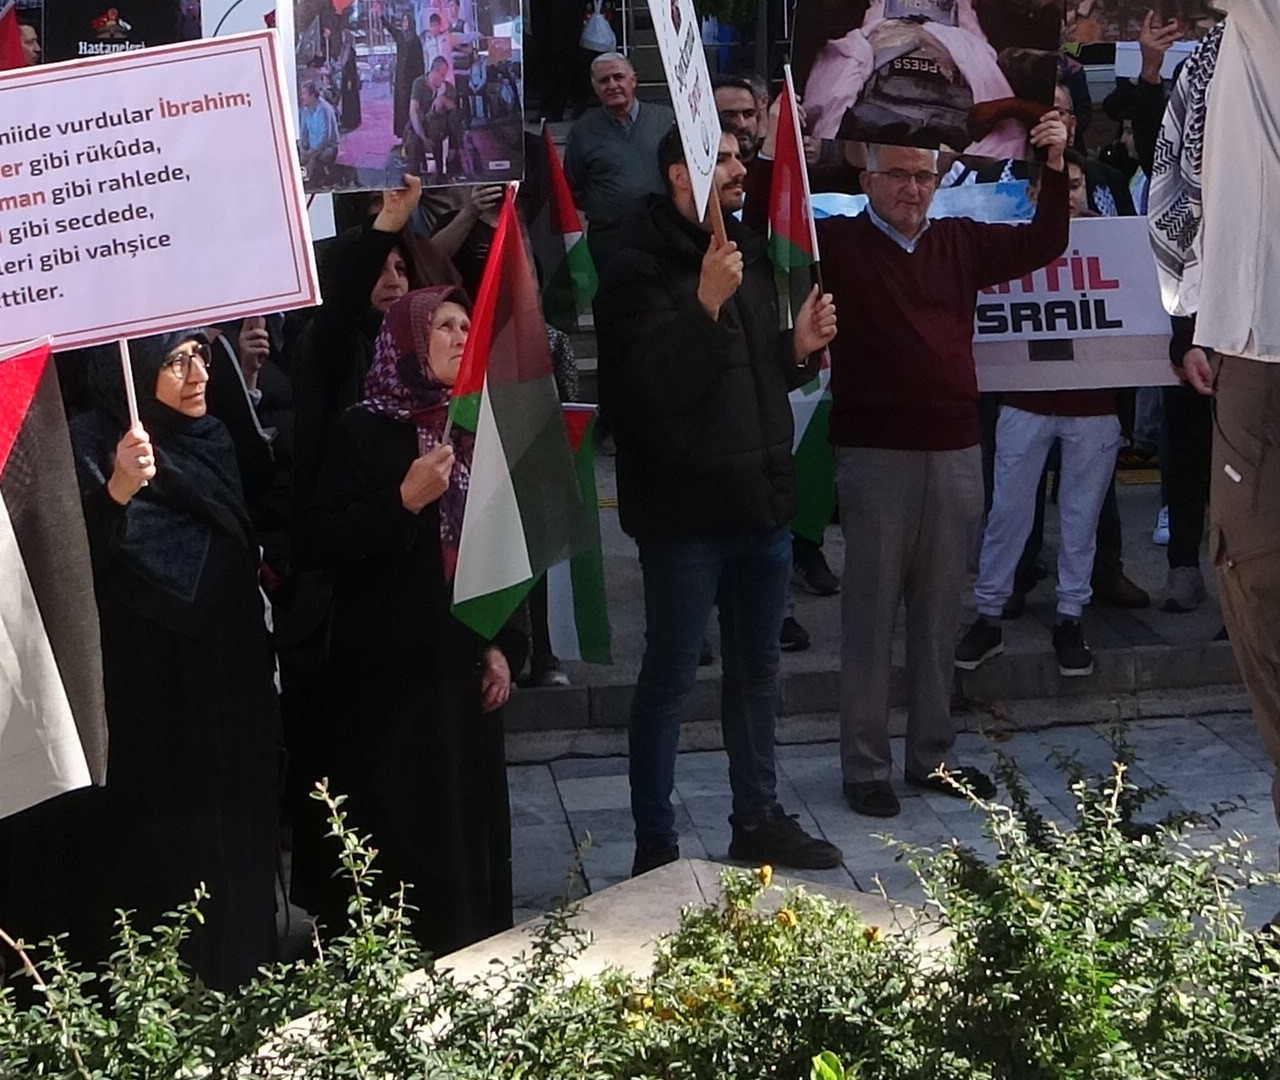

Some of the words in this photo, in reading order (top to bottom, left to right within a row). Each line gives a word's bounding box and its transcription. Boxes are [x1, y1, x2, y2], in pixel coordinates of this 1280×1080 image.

[57, 106, 153, 137] vurdular
[159, 90, 252, 120] İbrahim;
[29, 150, 70, 178] gibi
[76, 137, 162, 169] rükûda,
[51, 183, 93, 207] gibi
[98, 165, 191, 194] rahlede,
[9, 220, 50, 247] gibi
[56, 203, 155, 235] secdede,
[39, 247, 81, 273] gibi
[85, 231, 172, 262] vahşice
